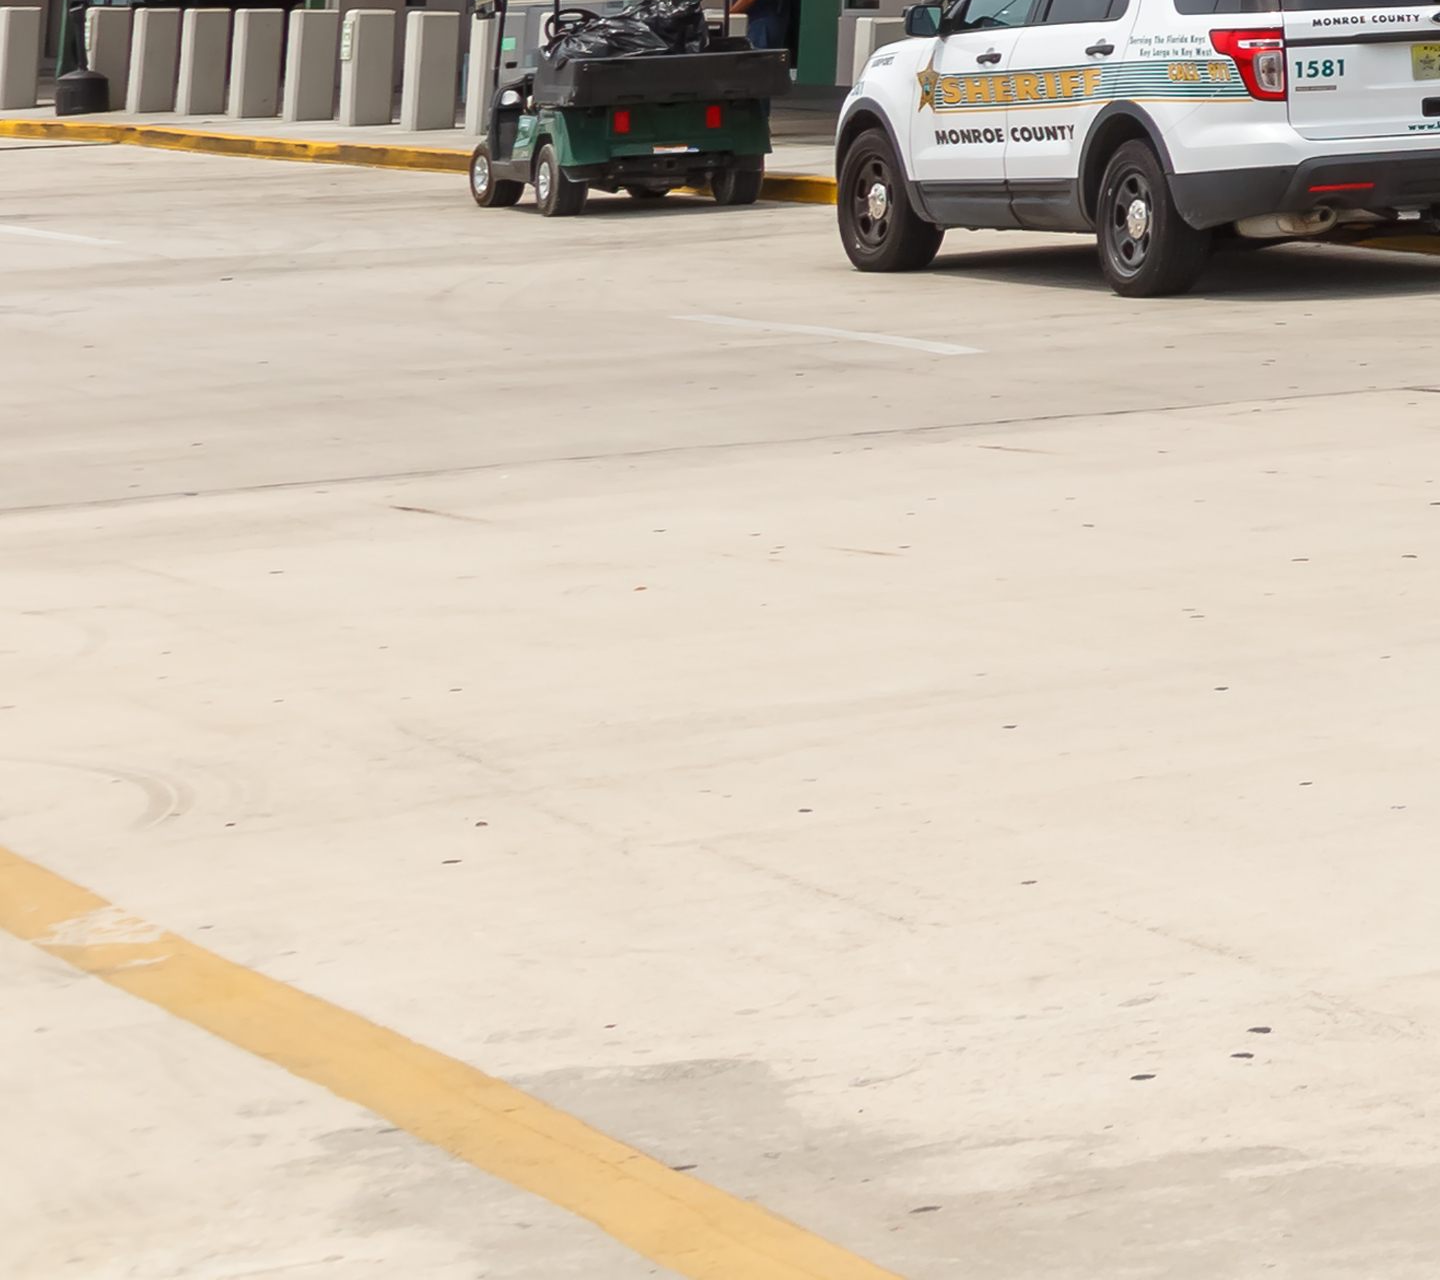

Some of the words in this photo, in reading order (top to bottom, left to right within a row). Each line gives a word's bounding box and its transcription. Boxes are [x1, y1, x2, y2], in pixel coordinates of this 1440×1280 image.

[1312, 16, 1366, 27] MONROE
[1371, 13, 1420, 24] COUNTY
[1195, 48, 1213, 57] West
[1167, 62, 1201, 83] CALL
[1207, 61, 1232, 83] 911
[1295, 59, 1345, 78] 1581
[940, 67, 1102, 105] SHERIFF
[934, 126, 1005, 146] MONROE
[1010, 123, 1075, 143] COUNTY
